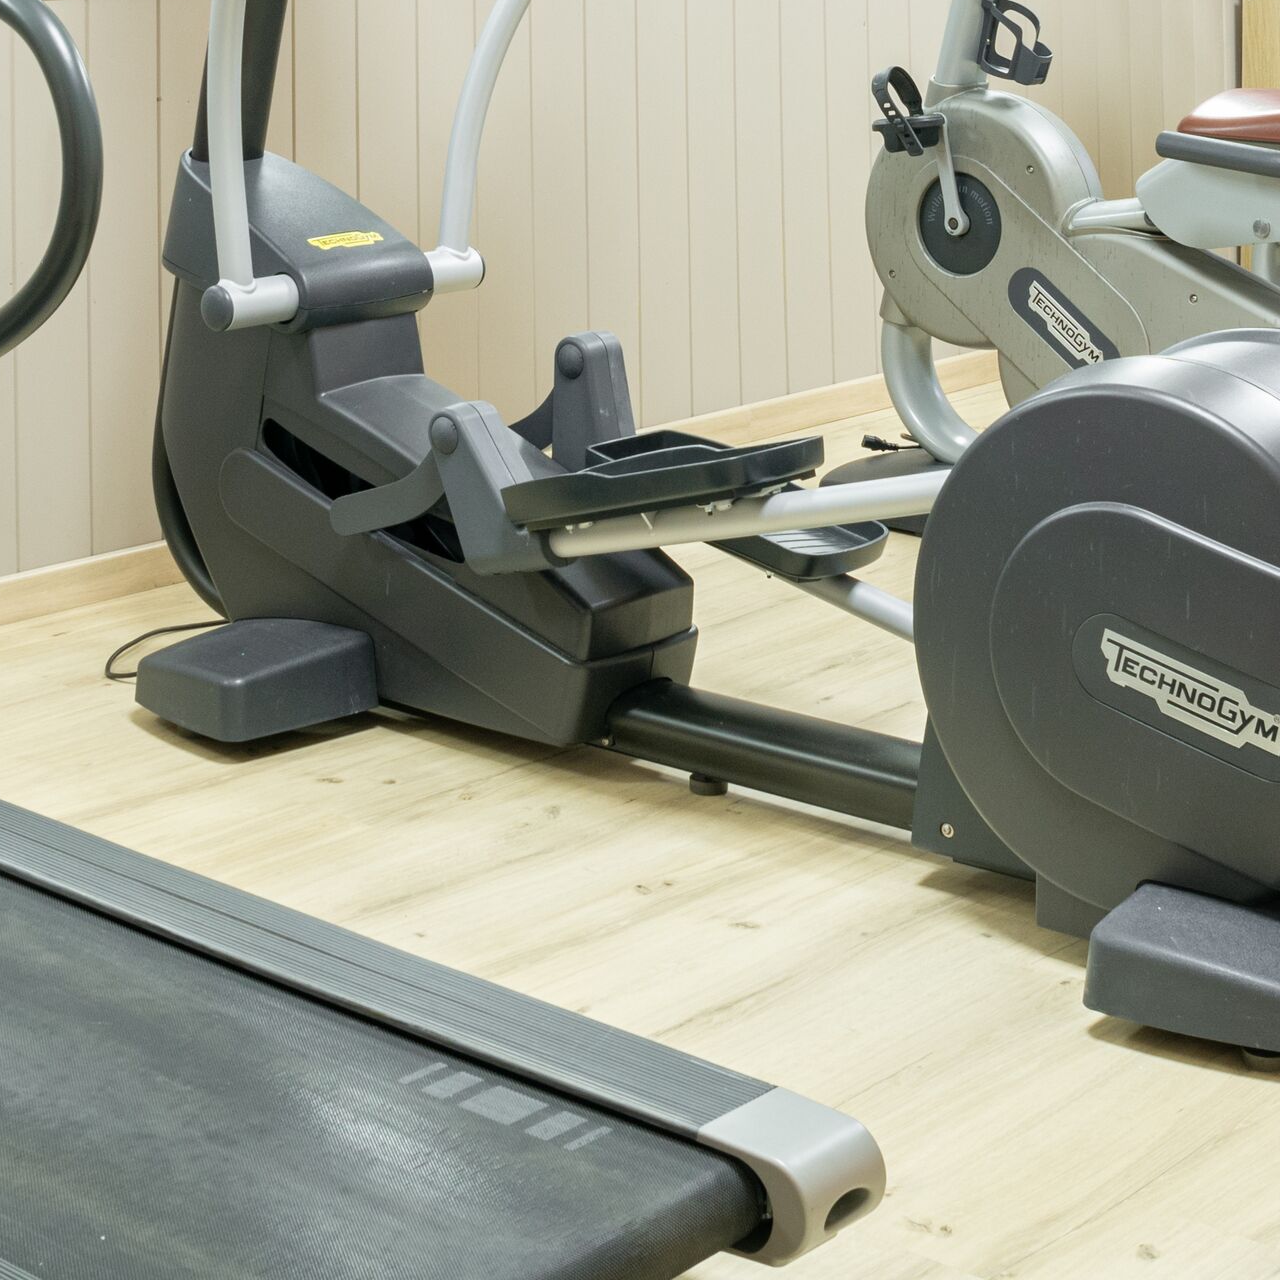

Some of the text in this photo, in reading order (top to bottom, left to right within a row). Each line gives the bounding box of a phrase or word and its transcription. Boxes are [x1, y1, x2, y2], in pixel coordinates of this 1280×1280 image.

[958, 184, 969, 194] in
[970, 190, 993, 226] motion
[311, 233, 380, 247] TECHNOGYM
[1032, 286, 1100, 364] TECHNOGYM
[1106, 637, 1280, 743] TECHNOGYM
